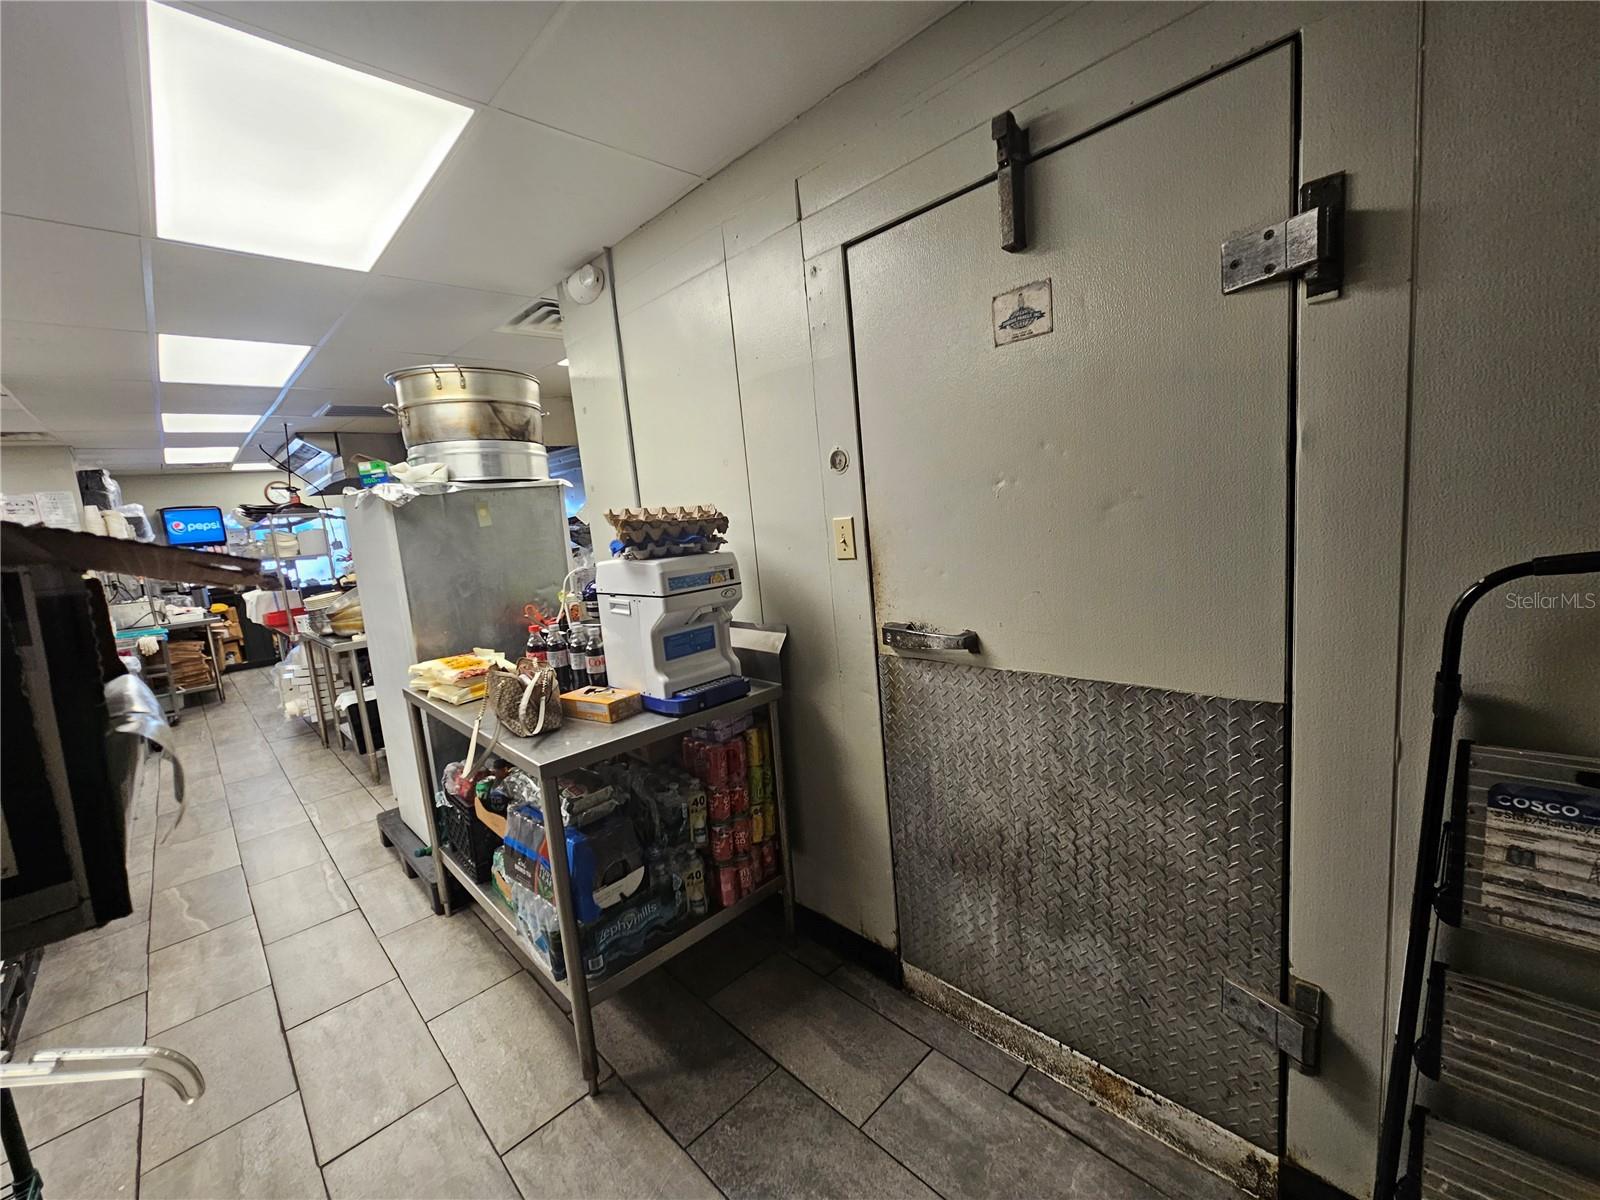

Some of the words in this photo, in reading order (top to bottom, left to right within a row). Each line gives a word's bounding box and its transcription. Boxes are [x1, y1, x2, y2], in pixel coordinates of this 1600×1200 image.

[187, 521, 220, 532] pepsi
[692, 796, 705, 807] 40
[1496, 794, 1580, 818] COSCO
[687, 870, 702, 880] 40
